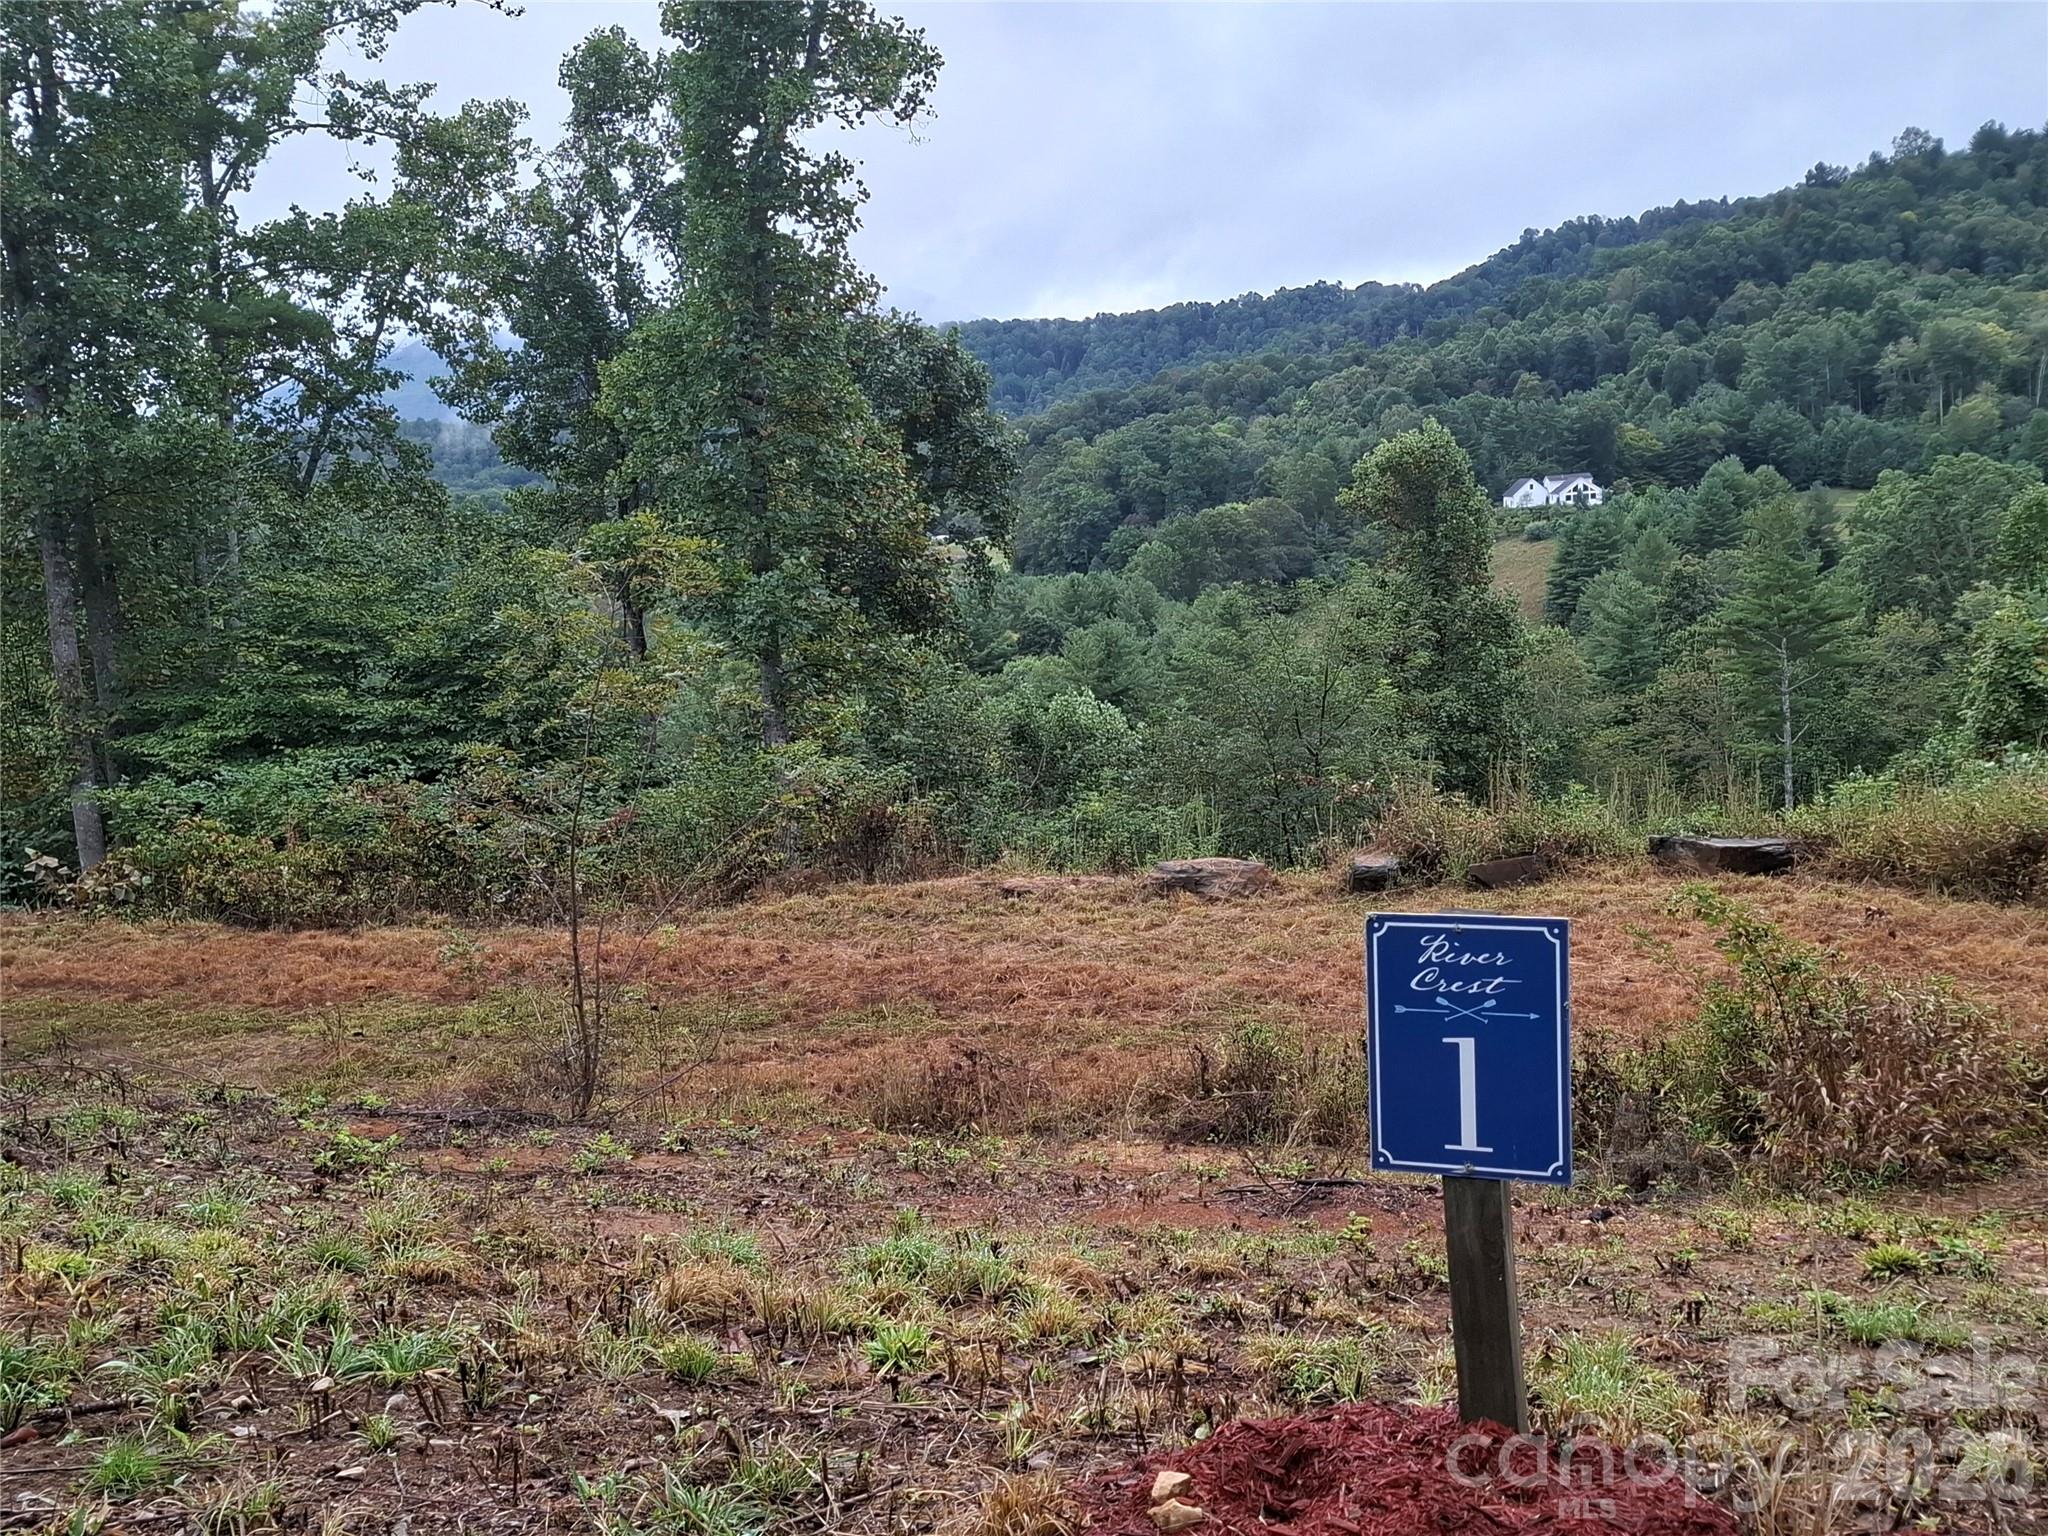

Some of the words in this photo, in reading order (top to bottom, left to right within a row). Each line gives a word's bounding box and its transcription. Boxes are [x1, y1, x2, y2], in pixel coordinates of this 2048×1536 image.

[1418, 933, 1513, 966] River
[1410, 966, 1522, 995] Crest
[1442, 1036, 1494, 1153] 1
